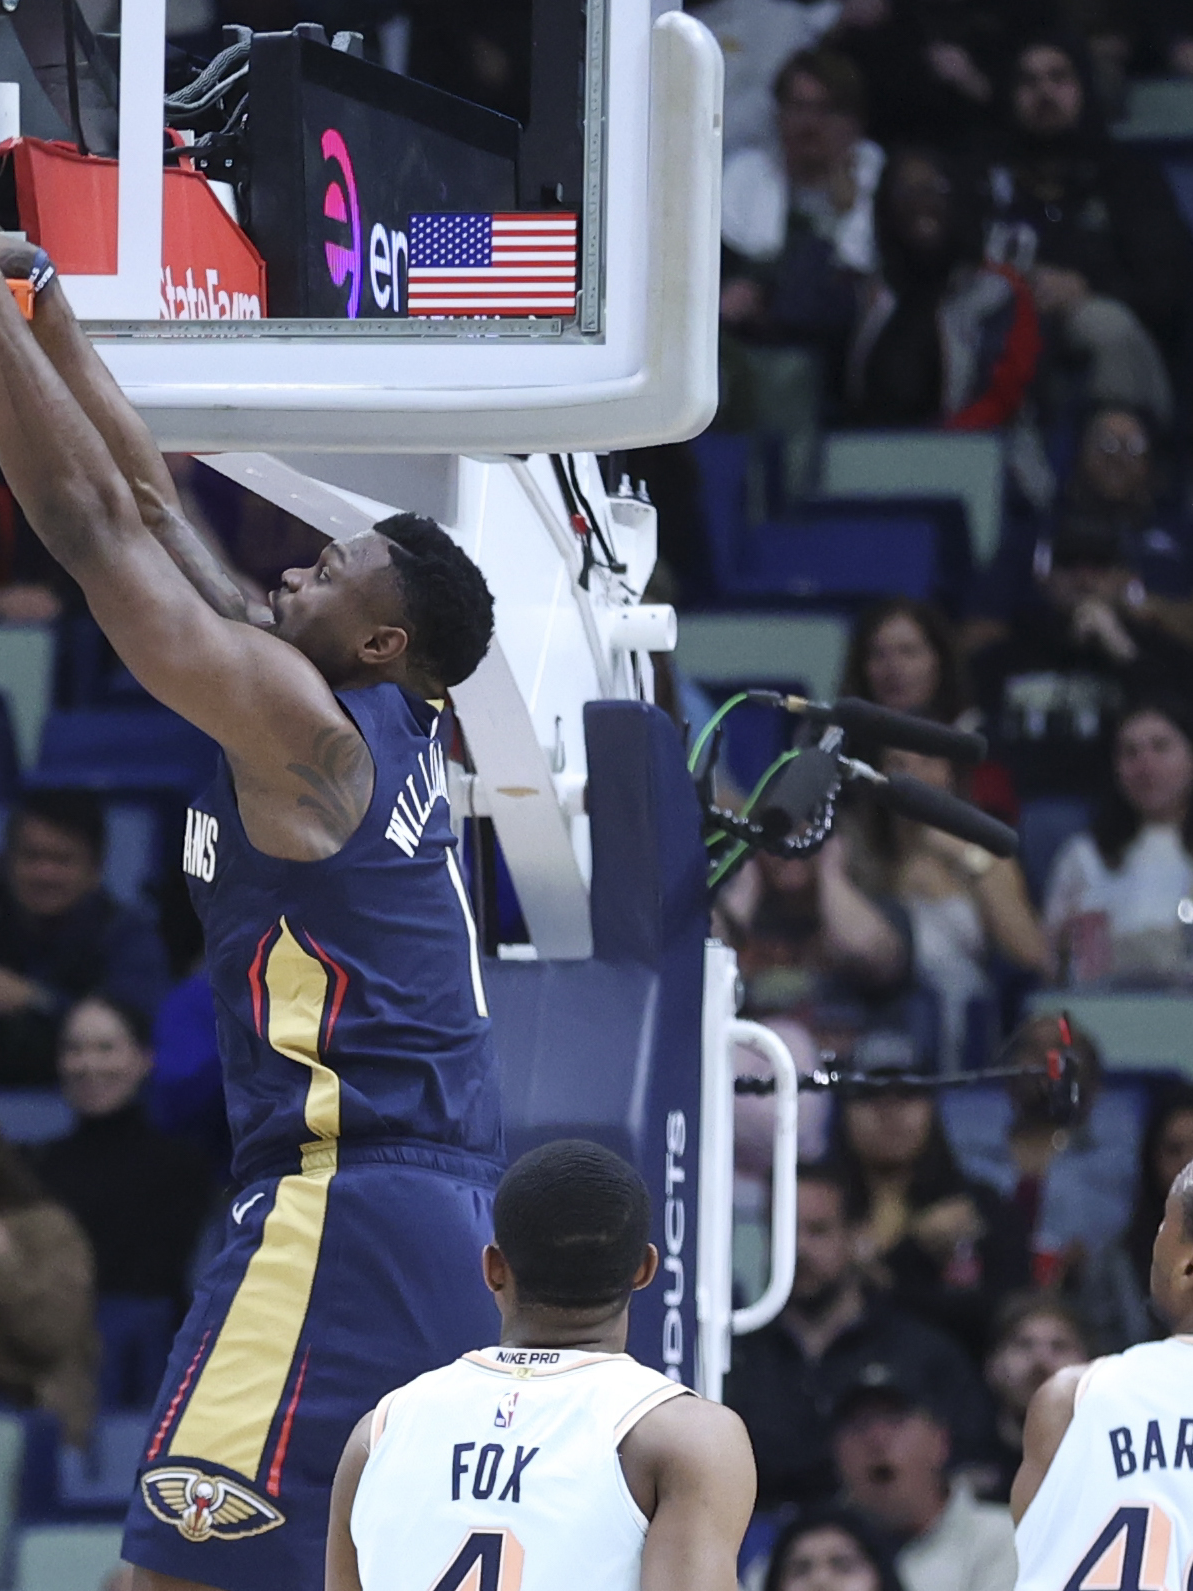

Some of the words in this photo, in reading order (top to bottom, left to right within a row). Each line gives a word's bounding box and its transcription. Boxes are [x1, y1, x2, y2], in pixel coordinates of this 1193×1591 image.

[183, 807, 219, 883] ANS
[496, 1352, 527, 1364] NIKE
[529, 1353, 560, 1364] PRO
[452, 1442, 540, 1503] FOX
